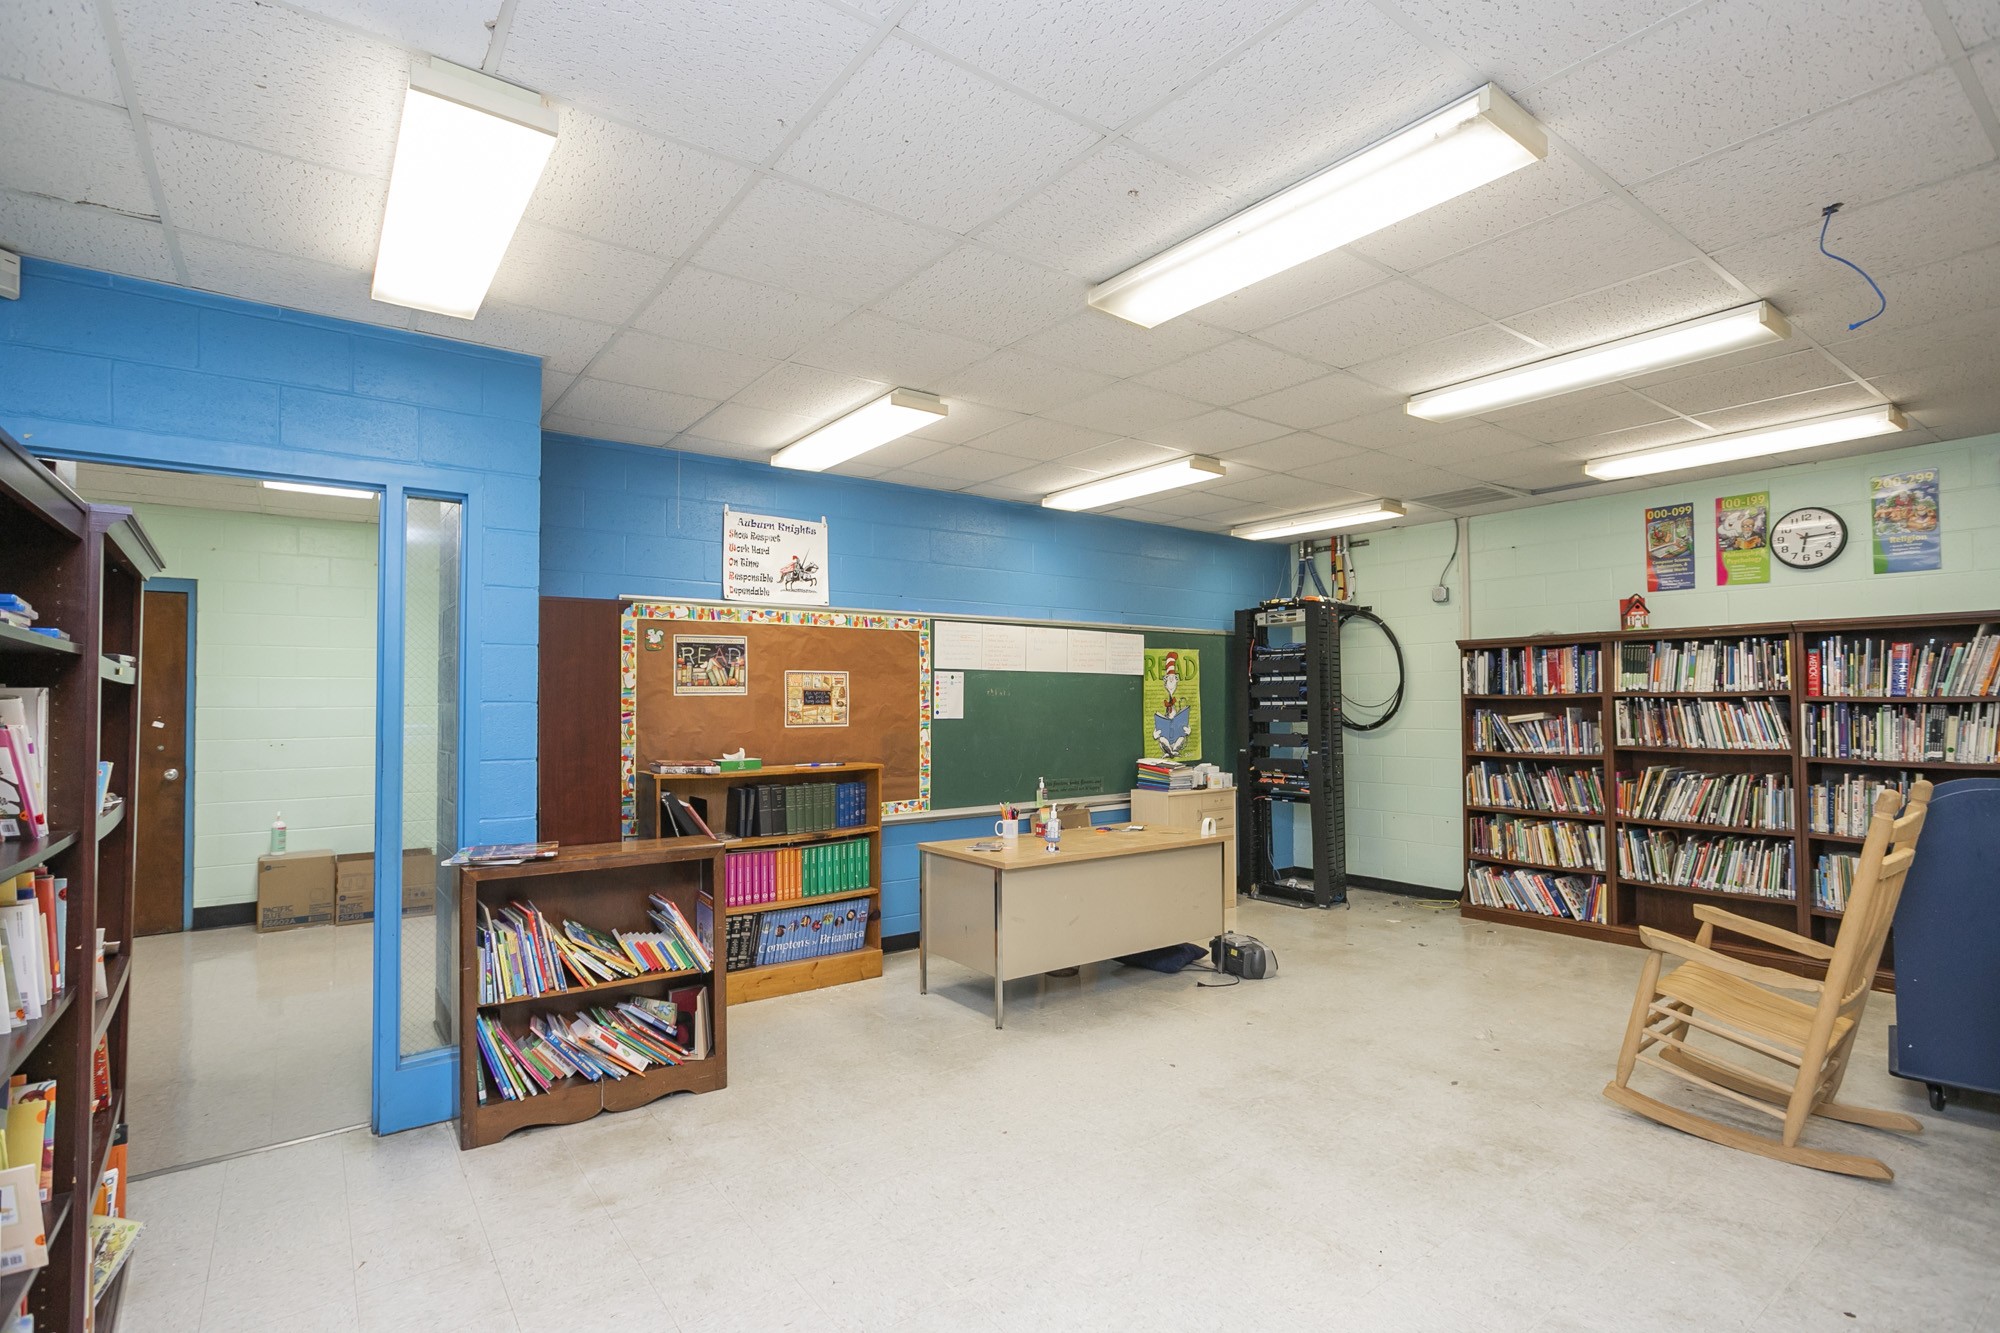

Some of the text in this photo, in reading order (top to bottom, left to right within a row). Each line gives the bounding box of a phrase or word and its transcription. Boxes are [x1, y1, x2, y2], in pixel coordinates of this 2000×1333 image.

[1874, 472, 1934, 489] 200-299
[1722, 495, 1765, 508] 100-199
[1647, 506, 1692, 519] 000-099
[738, 518, 817, 535] Auburn Knights
[729, 529, 780, 543] Show Respect
[1889, 534, 1927, 543] Religion
[729, 544, 770, 555] Work Hard
[729, 558, 759, 568] On Time
[729, 571, 773, 583] Responsible
[729, 586, 770, 596] Dependable
[681, 647, 741, 666] READ
[1145, 655, 1197, 681] READ
[1808, 655, 1818, 677] MERCK
[1899, 663, 1908, 689] HOME
[758, 938, 810, 954] Compton's
[820, 929, 865, 944] Britannica
